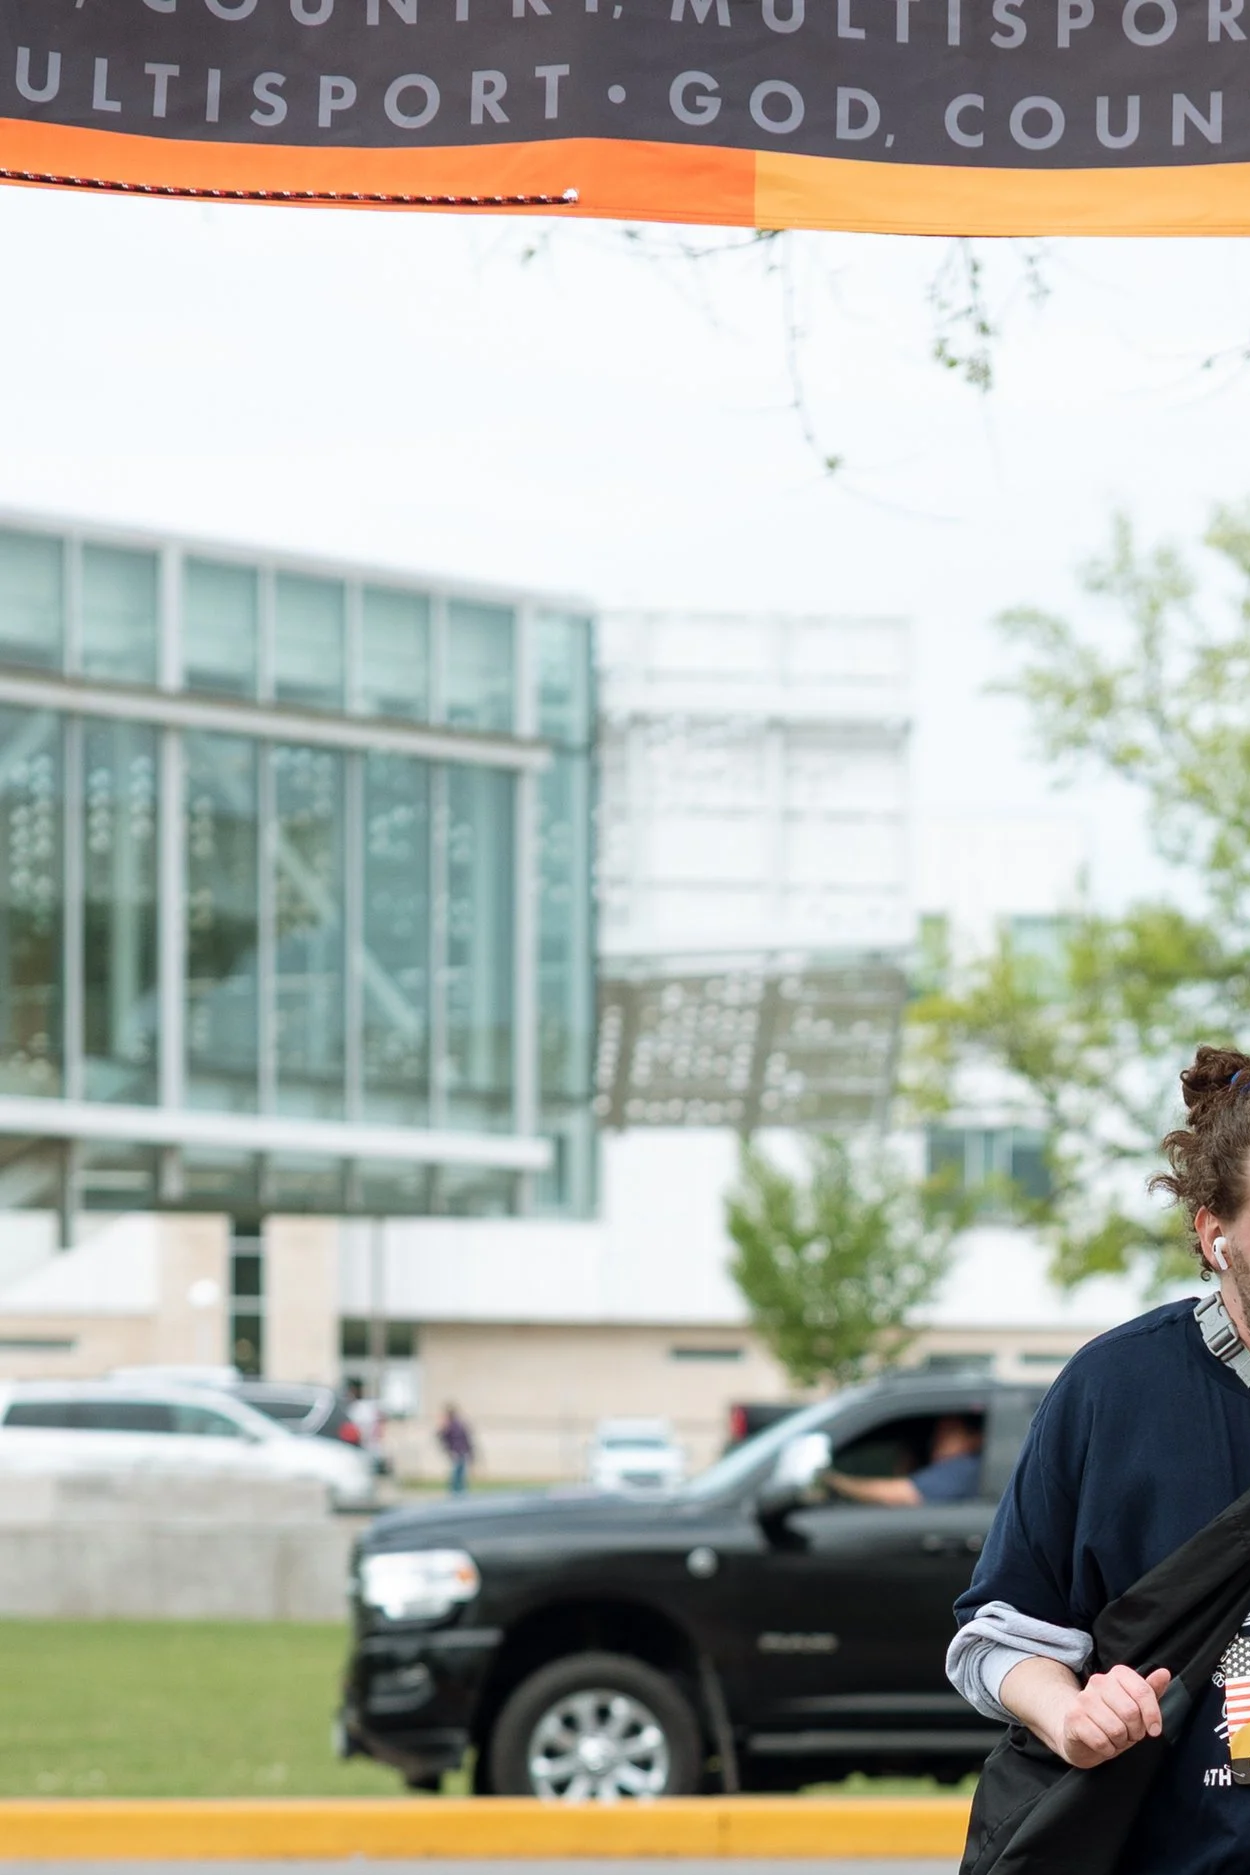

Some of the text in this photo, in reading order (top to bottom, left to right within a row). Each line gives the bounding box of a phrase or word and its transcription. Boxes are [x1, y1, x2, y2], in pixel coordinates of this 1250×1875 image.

[15, 46, 570, 128] ULTISPORT
[669, 71, 894, 147] GOD,
[1203, 1768, 1231, 1786] 4TH
